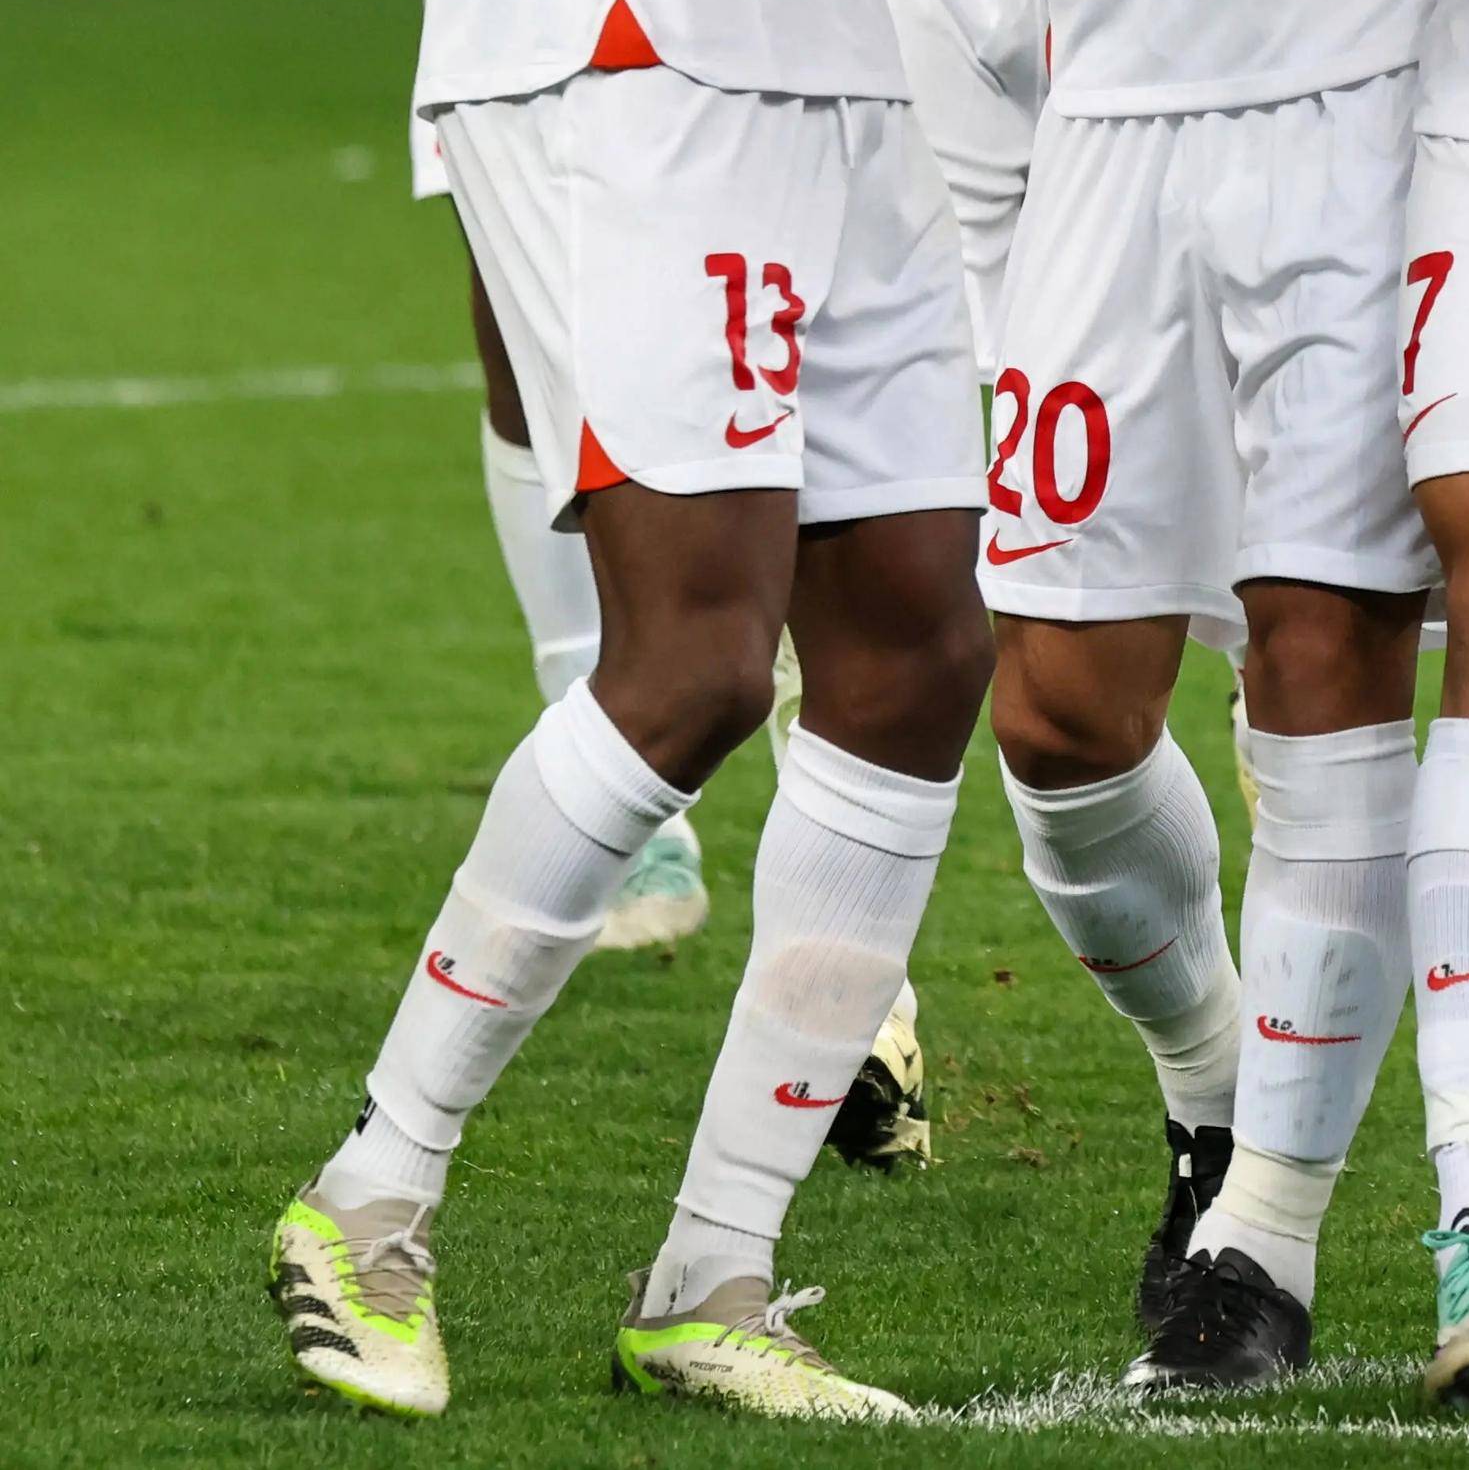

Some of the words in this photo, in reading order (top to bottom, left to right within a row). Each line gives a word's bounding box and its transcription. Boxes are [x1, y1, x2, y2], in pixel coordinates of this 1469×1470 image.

[703, 252, 806, 397] 13
[1402, 250, 1455, 396] 7
[986, 367, 1111, 525] 20
